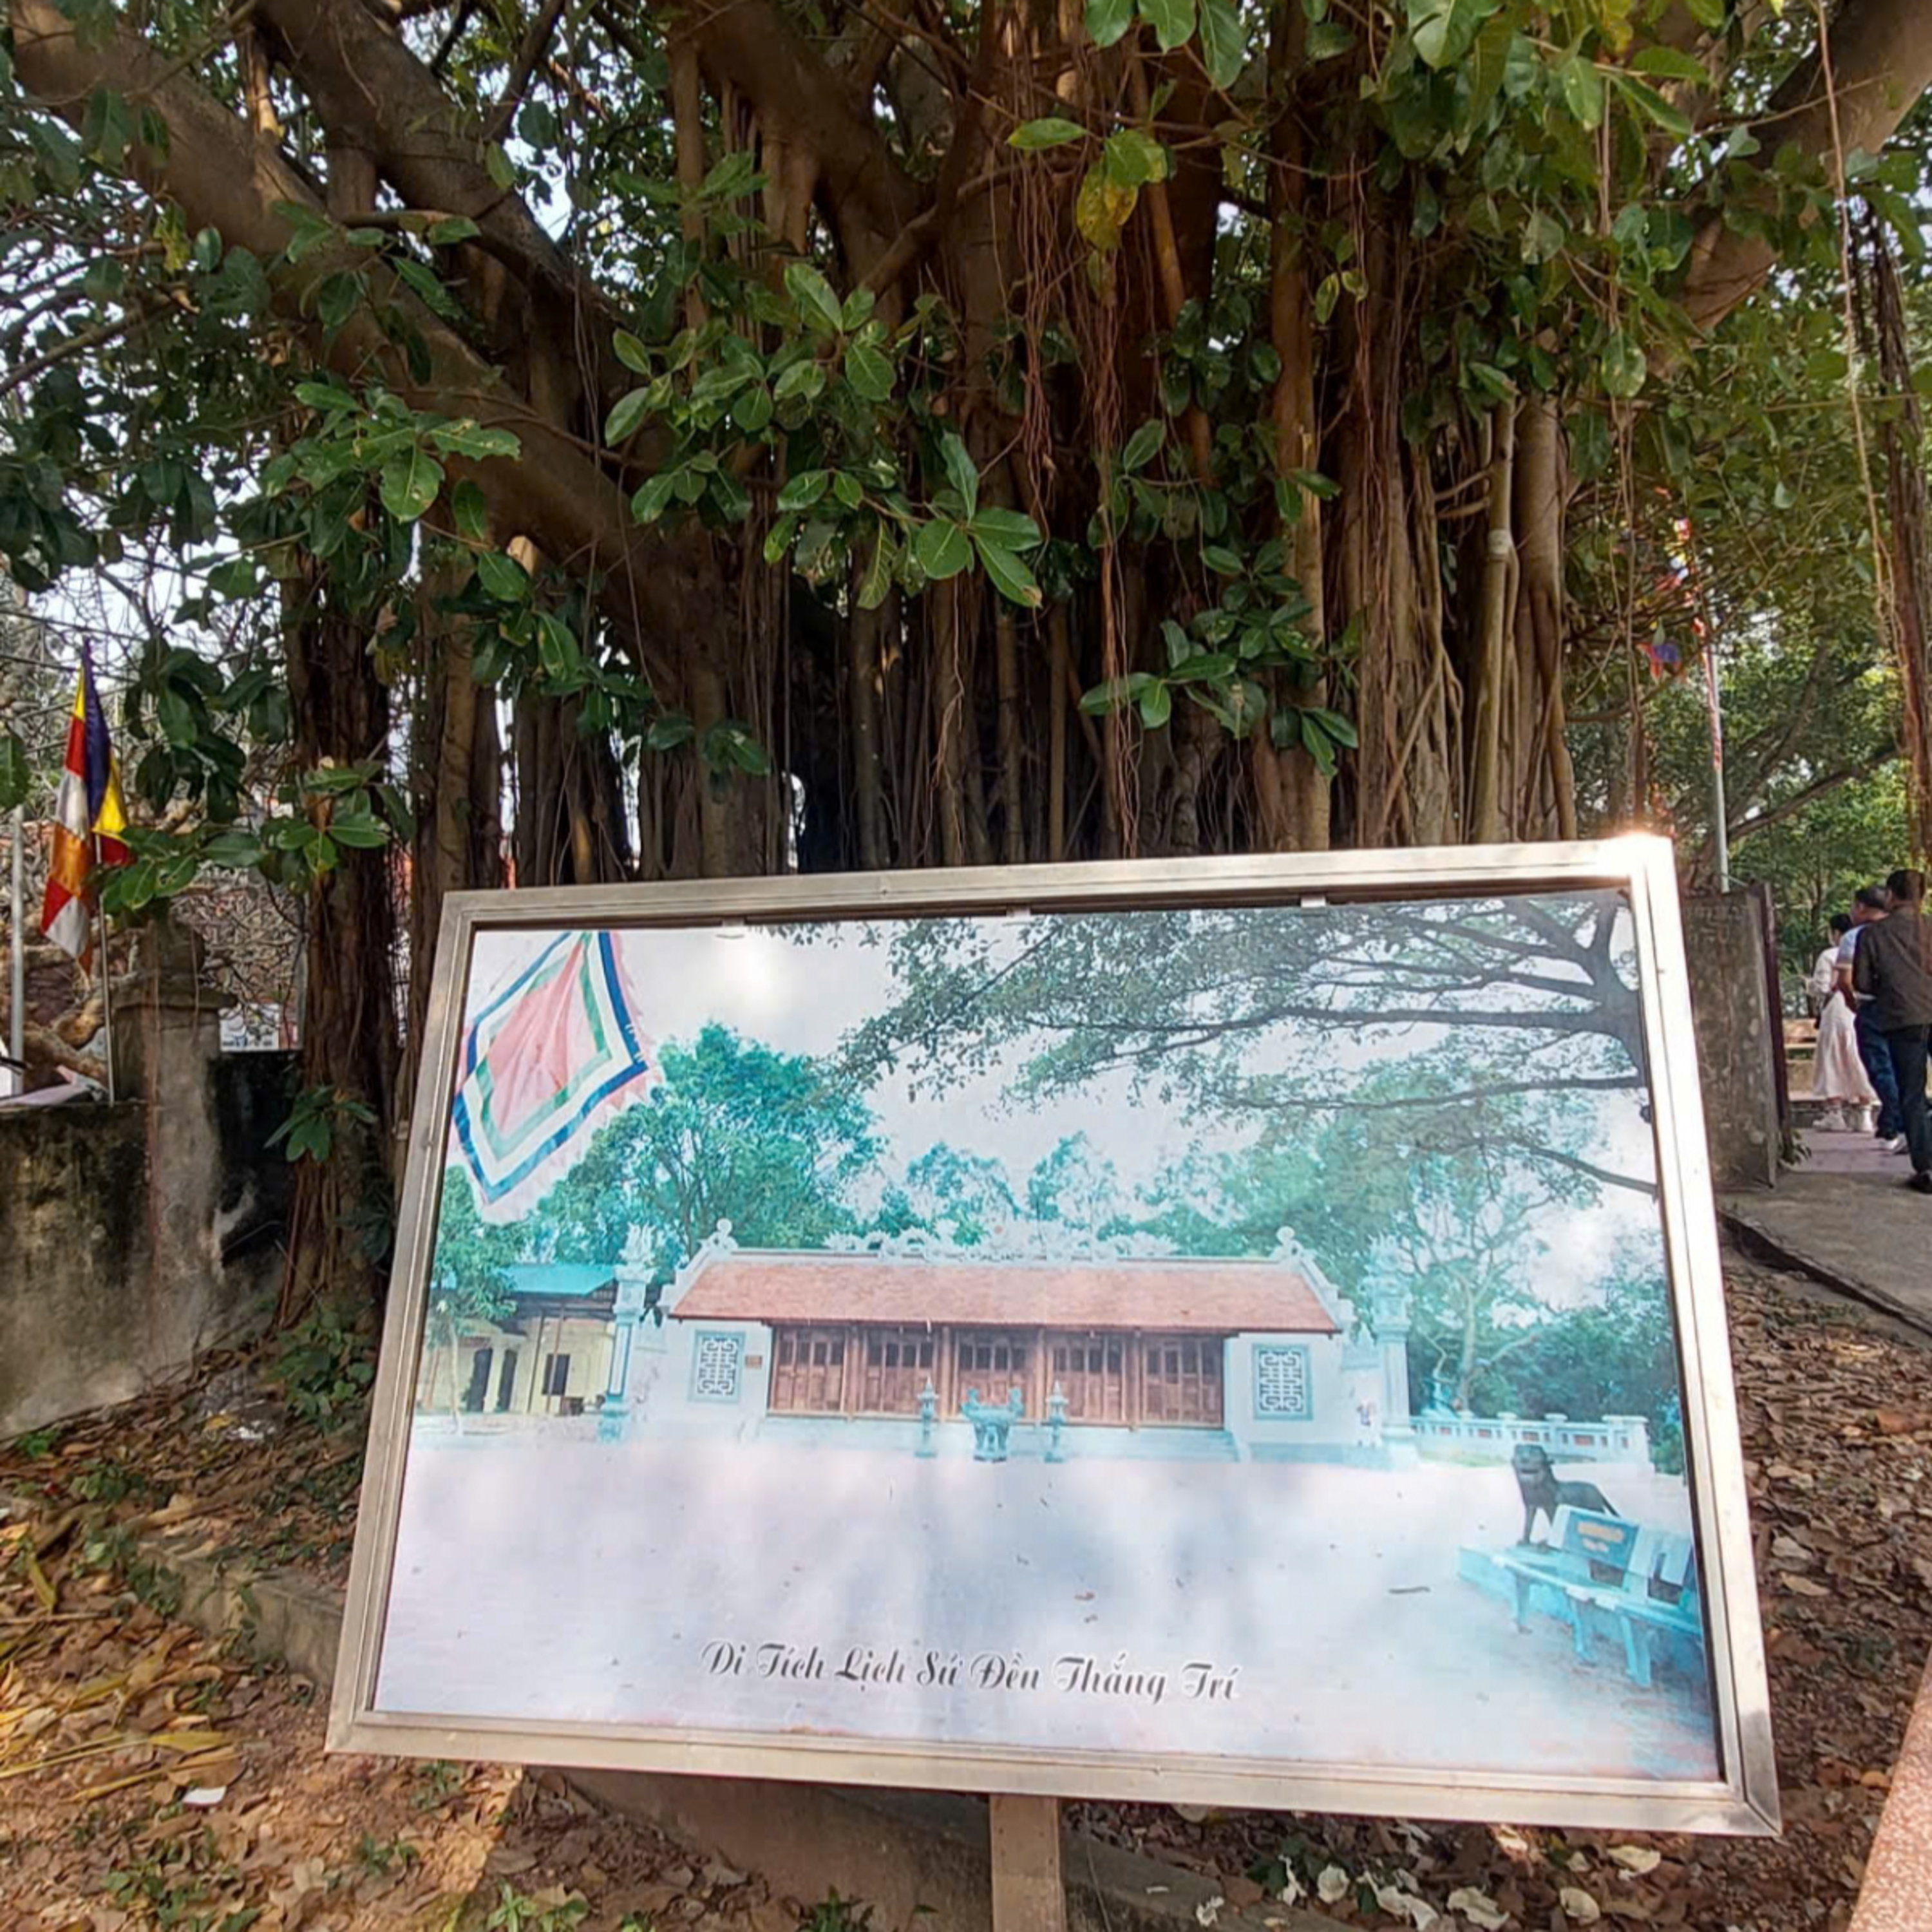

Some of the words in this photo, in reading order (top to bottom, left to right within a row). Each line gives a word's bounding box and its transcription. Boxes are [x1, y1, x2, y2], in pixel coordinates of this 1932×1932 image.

[701, 1641, 746, 1676] Di
[757, 1643, 824, 1679] Tích
[835, 1647, 905, 1692] Lịch
[970, 1652, 1040, 1690] Đền
[1054, 1652, 1166, 1705] Thắng
[1182, 1662, 1240, 1700] Trí
